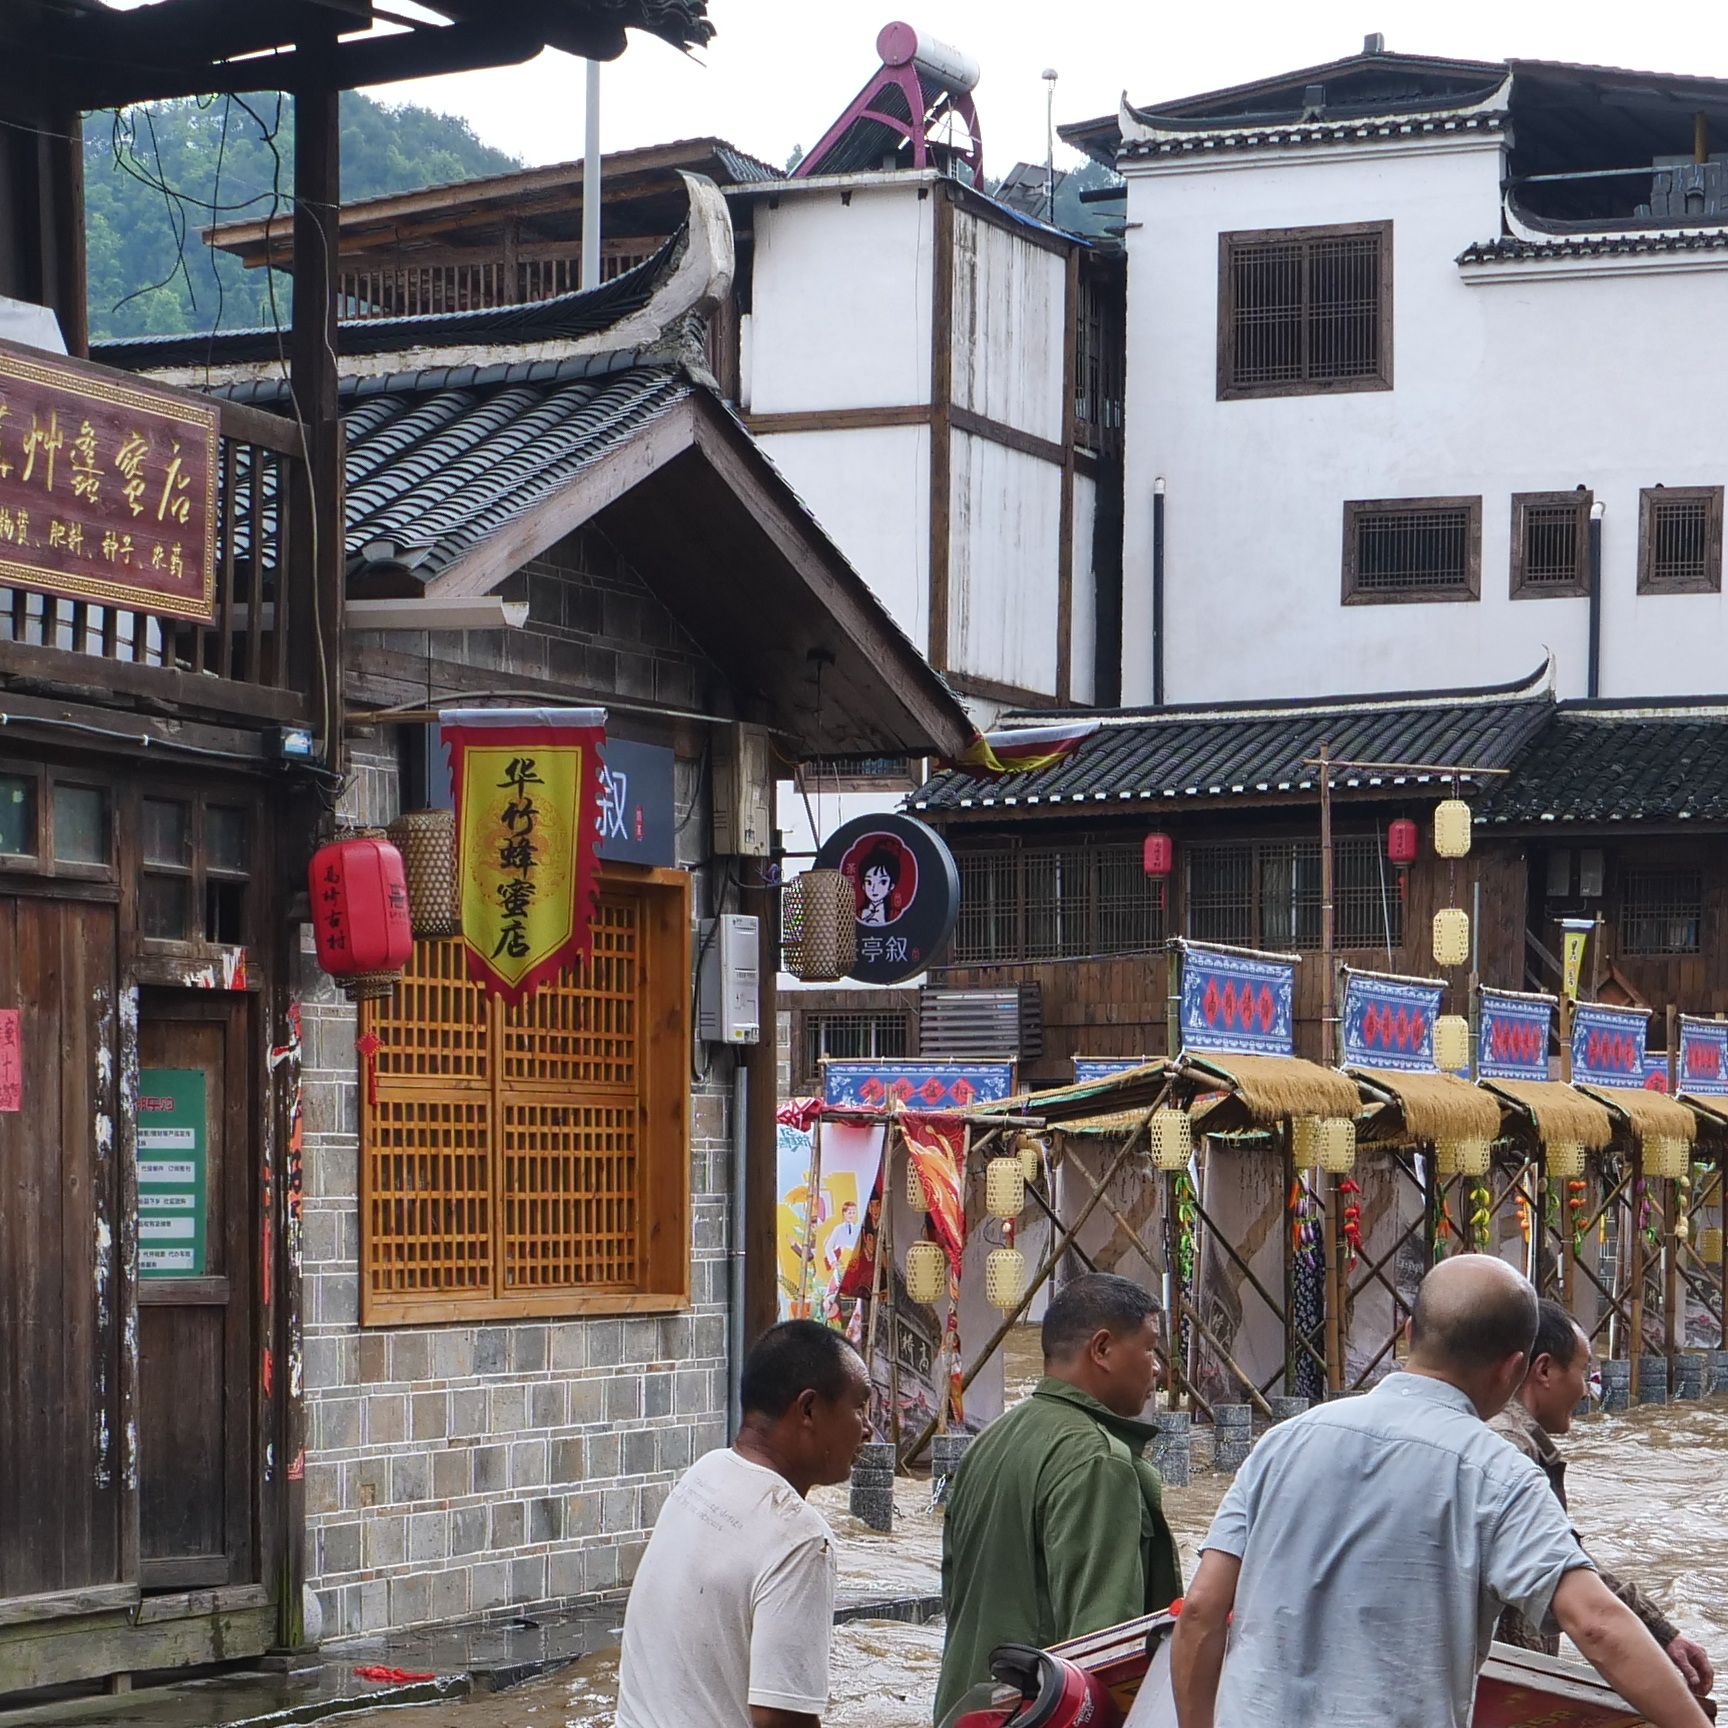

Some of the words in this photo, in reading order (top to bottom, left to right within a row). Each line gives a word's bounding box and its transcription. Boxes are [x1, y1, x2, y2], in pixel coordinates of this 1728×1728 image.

[490, 757, 545, 960] 华竹蜂蜜店
[851, 935, 908, 963] 亭叙
